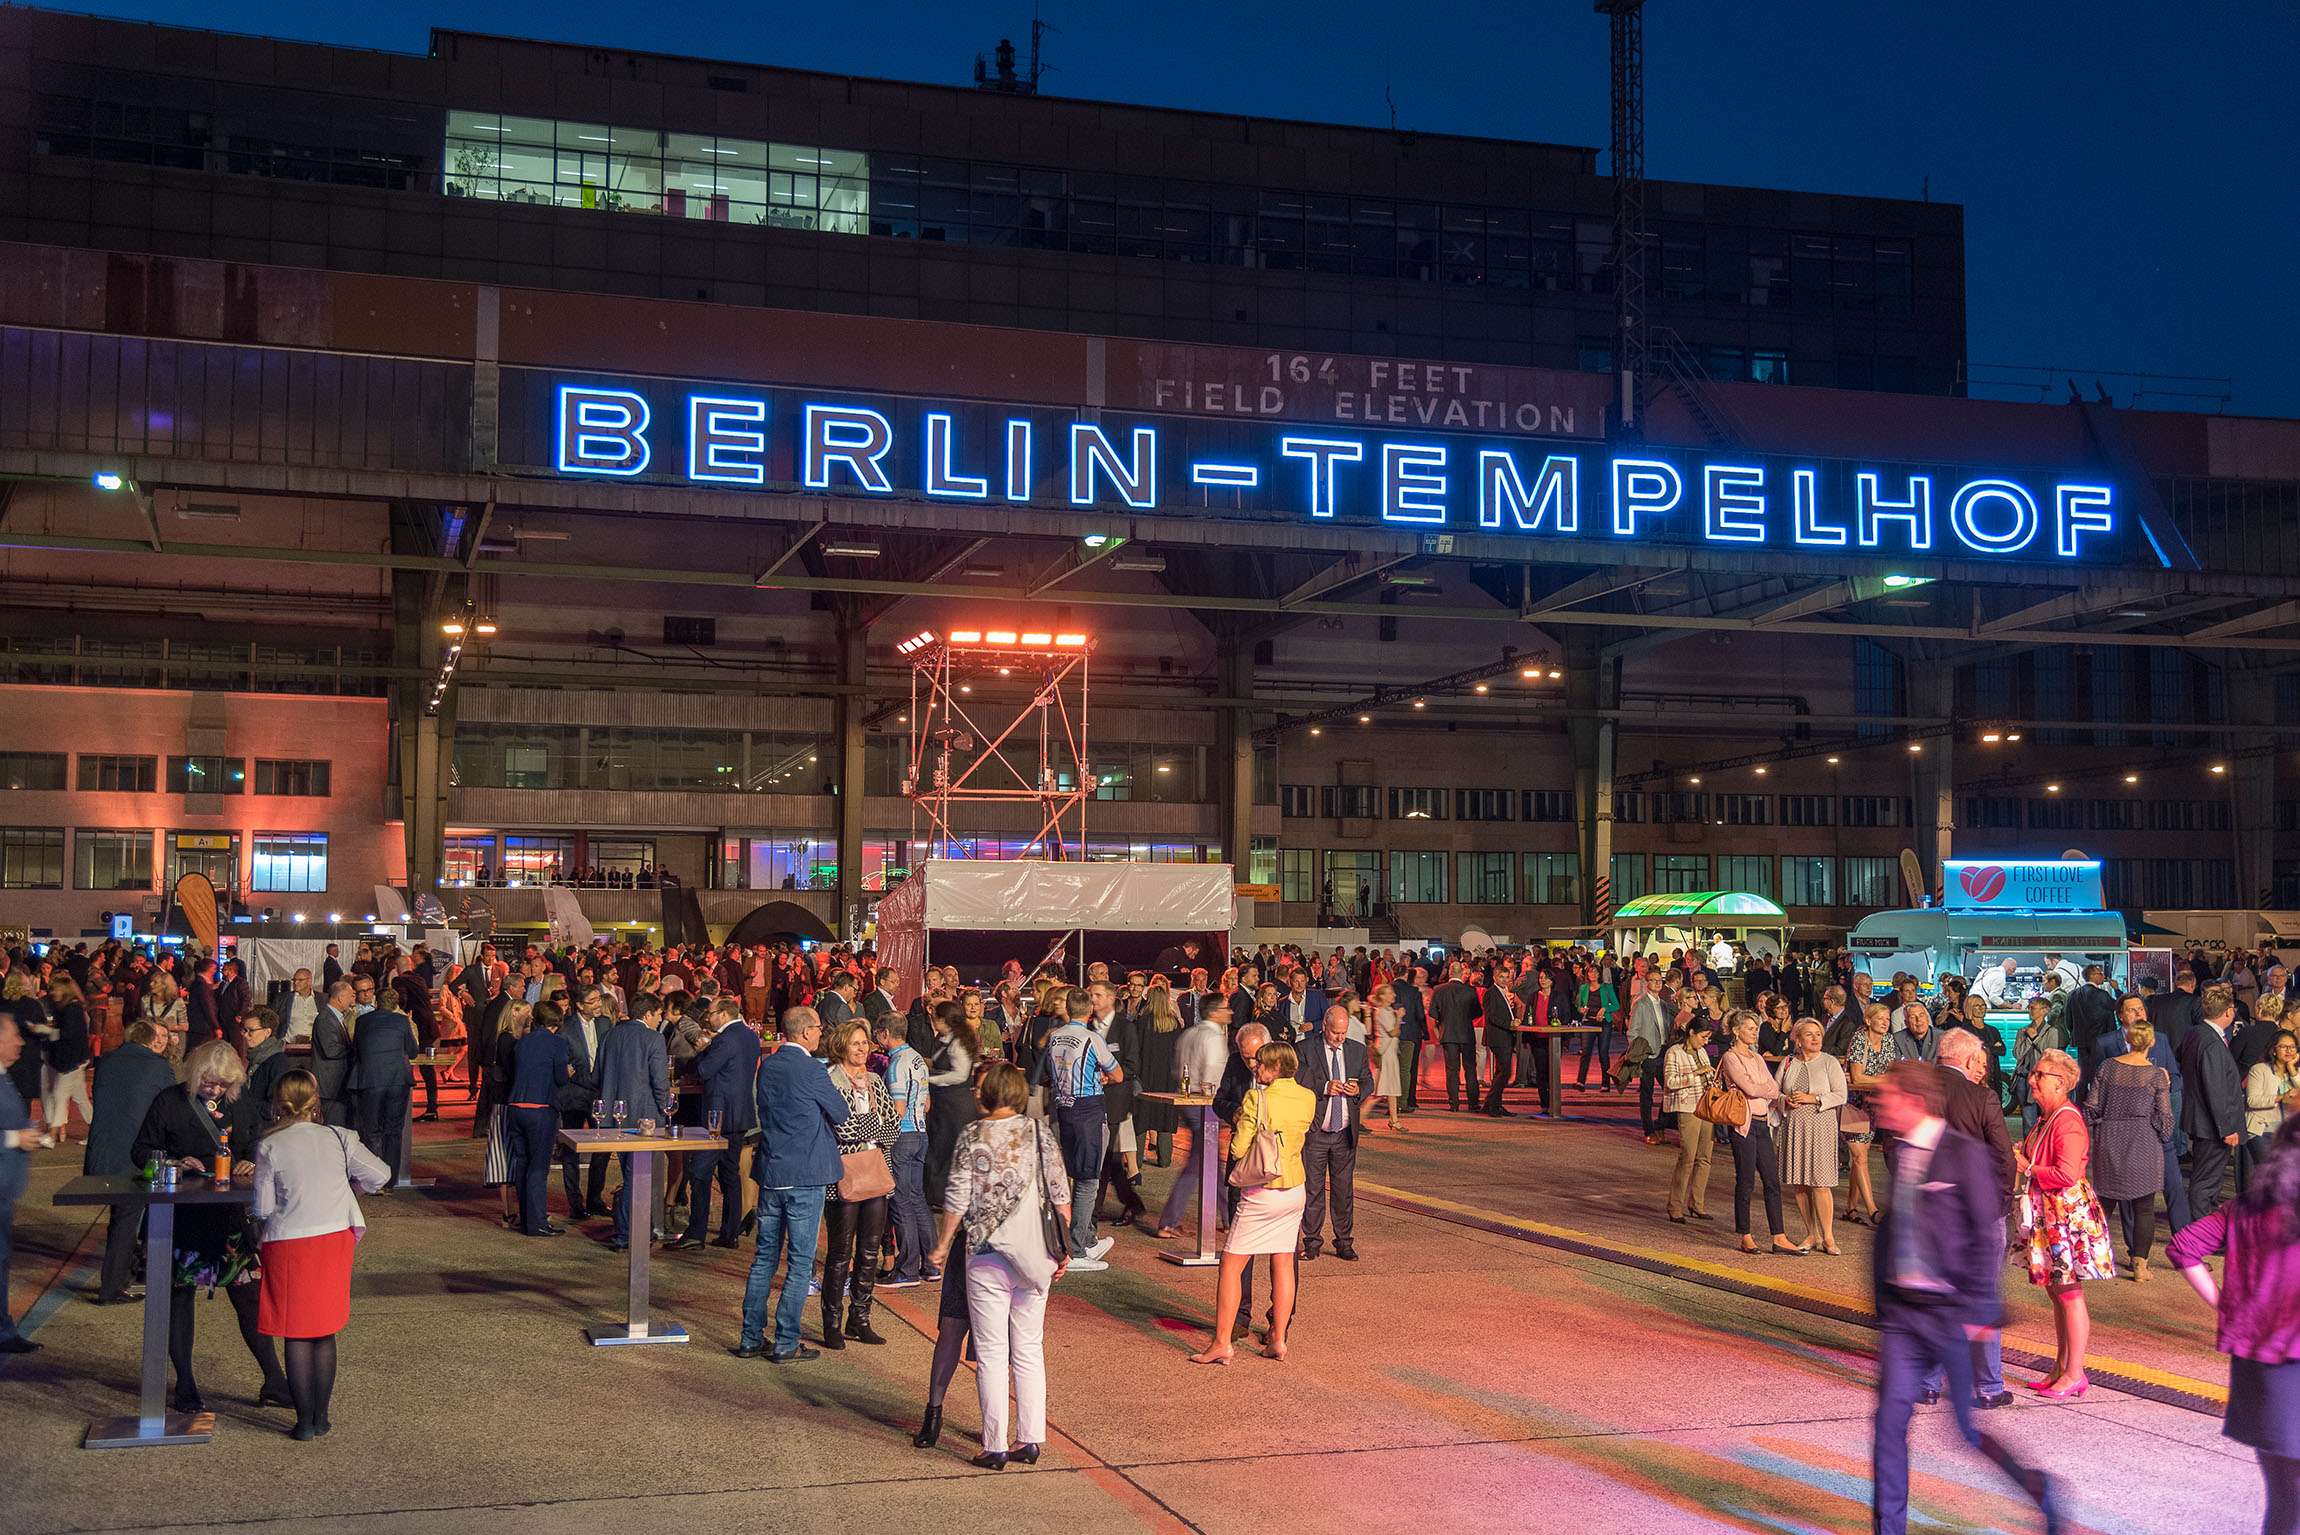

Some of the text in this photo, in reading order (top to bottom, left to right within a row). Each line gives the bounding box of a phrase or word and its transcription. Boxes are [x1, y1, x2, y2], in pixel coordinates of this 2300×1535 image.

[1266, 354, 1474, 395] 164 FEET
[1155, 380, 1576, 433] FIELD ELEVATION
[2013, 866, 2084, 883] FIRST LOVE
[2025, 887, 2072, 903] COFFEE
